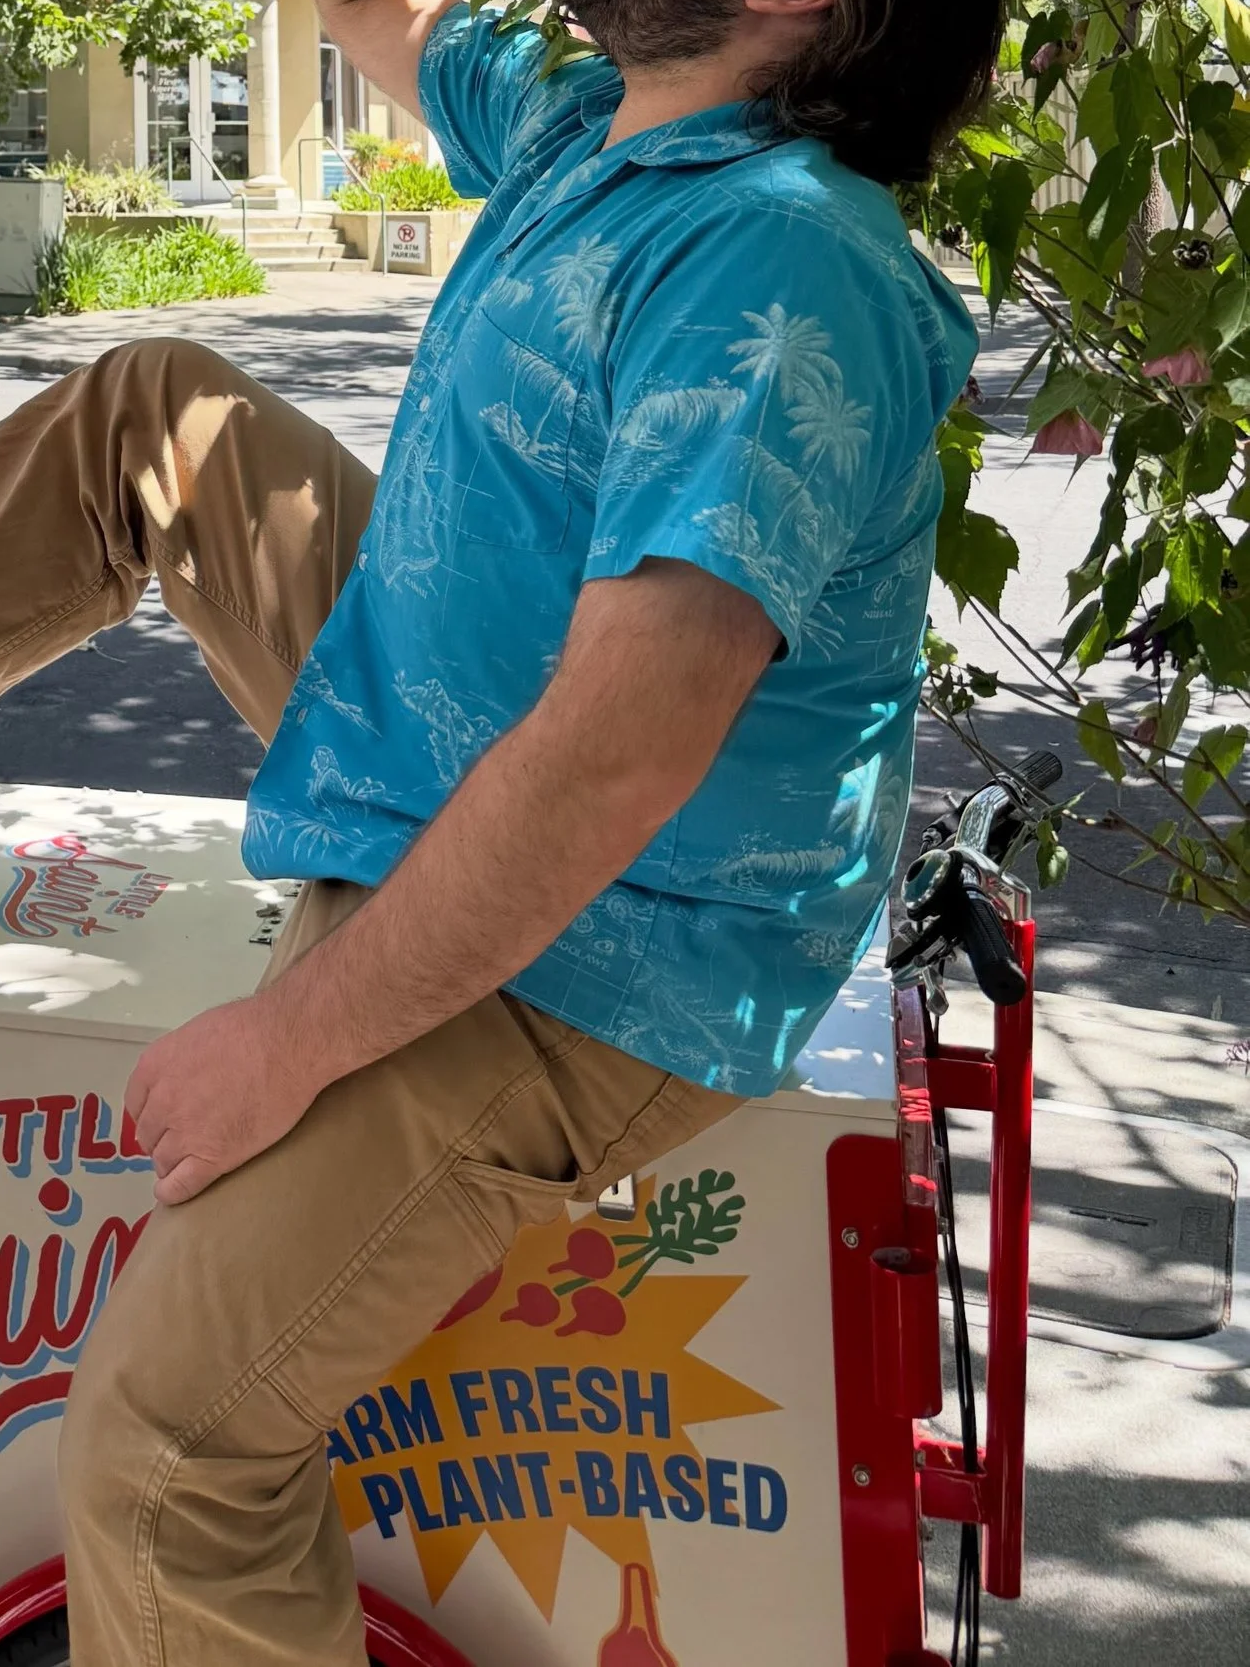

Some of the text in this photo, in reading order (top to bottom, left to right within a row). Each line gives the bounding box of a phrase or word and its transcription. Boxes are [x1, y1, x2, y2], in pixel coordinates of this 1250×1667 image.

[391, 251, 421, 260] PARKING
[404, 243, 419, 251] ATM
[106, 872, 174, 920] LITTLE
[326, 1366, 672, 1471] ARM FRESH
[359, 1450, 788, 1540] PLANT-BASED
